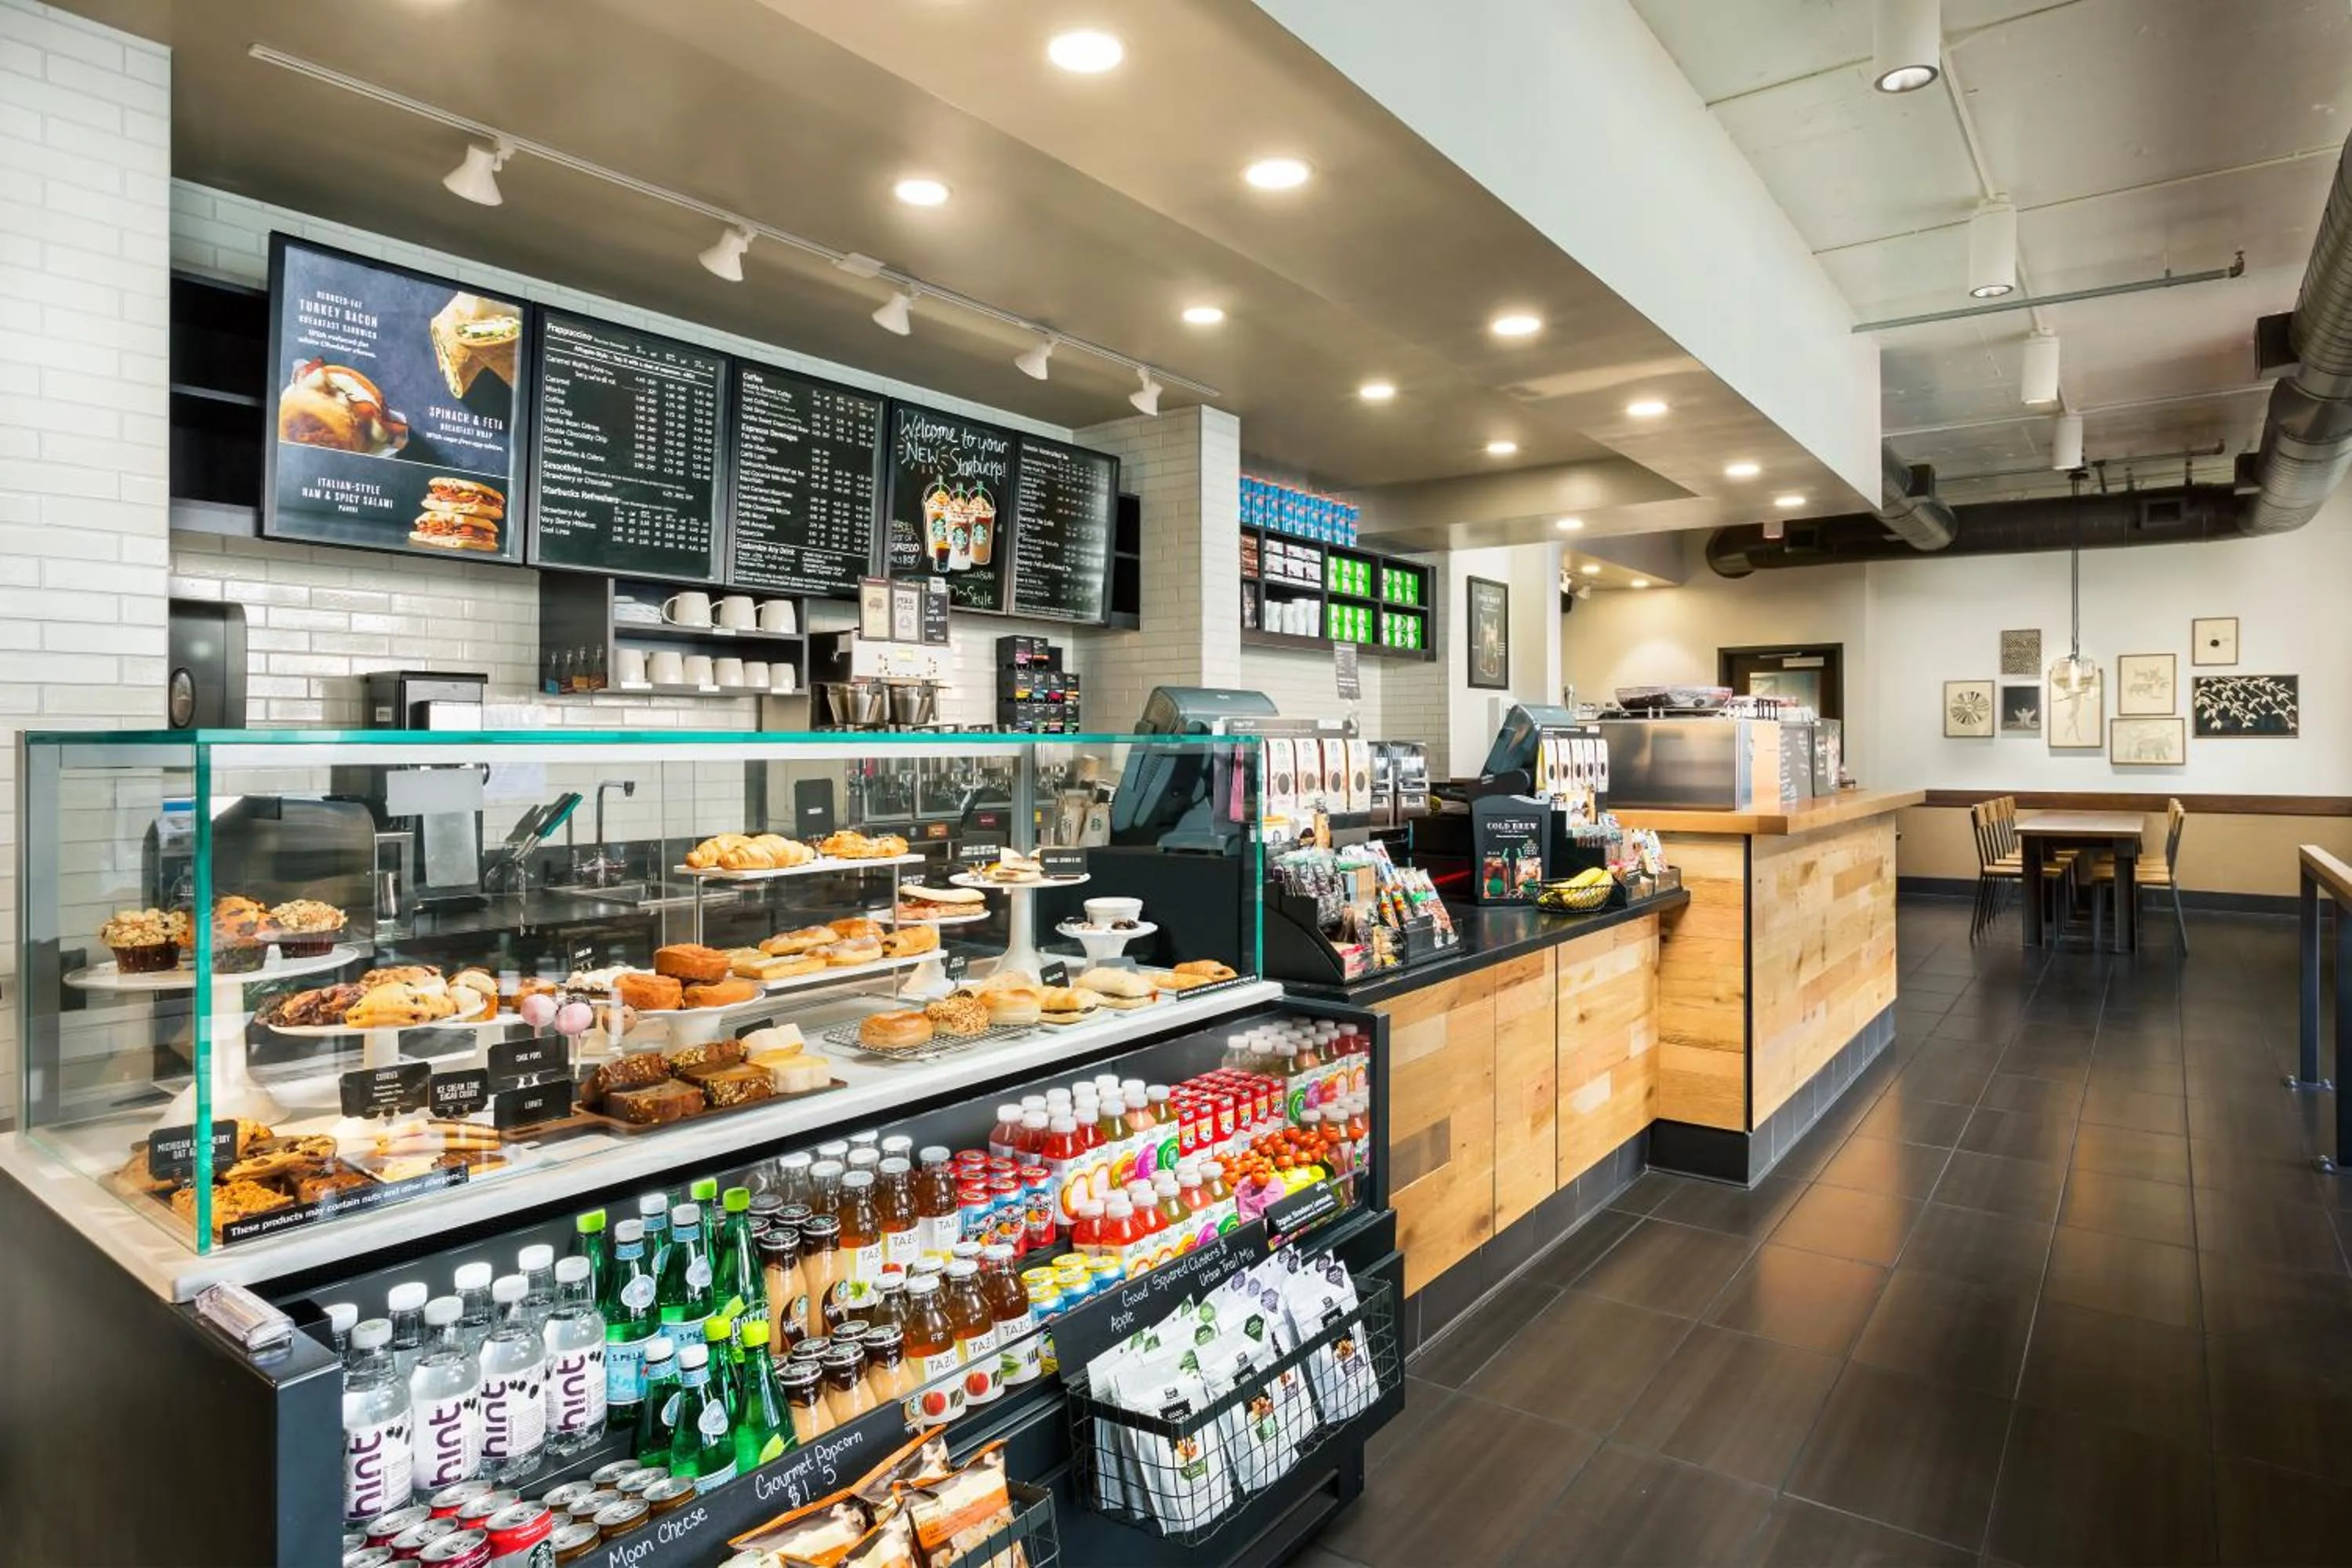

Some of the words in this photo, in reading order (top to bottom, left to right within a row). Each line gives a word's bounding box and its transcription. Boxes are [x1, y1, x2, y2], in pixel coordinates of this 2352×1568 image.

[299, 299, 340, 318] TURKEY
[345, 310, 377, 328] BACON
[299, 315, 339, 330] BREAKFAST
[546, 322, 593, 341] Frappuccino
[546, 375, 570, 386] Caramel
[742, 372, 764, 383] Coffee
[545, 395, 564, 405] Coffee
[429, 406, 470, 424] SPINACH
[473, 417, 479, 426] &
[482, 418, 503, 430] FETA
[897, 408, 958, 443] Welcome
[961, 427, 975, 448] to
[976, 436, 1009, 461] your
[543, 460, 582, 474] Smoothies
[901, 441, 939, 465] NEW
[949, 448, 1007, 485] Starbucks!
[301, 487, 321, 500] HAM
[325, 491, 332, 501] &
[333, 492, 360, 506] SPICY
[363, 495, 394, 509] SALAMI
[318, 477, 381, 495] ITALIAN-STYLE
[543, 485, 580, 498] Starbucks
[172, 1149, 187, 1160] OAT
[230, 1223, 260, 1237] These
[262, 1212, 304, 1232] products
[305, 1206, 325, 1219] may
[326, 1197, 361, 1213] contain
[361, 1192, 382, 1205] nuts
[383, 1185, 400, 1198] and
[401, 1181, 423, 1194] other
[1111, 1311, 1134, 1333] Apple
[1199, 1269, 1222, 1287] Urban
[1219, 1254, 1238, 1272] Trail
[1240, 1247, 1255, 1263] Mix
[1122, 1281, 1149, 1307] Good
[556, 1354, 586, 1432] hint
[481, 1379, 507, 1457] hint
[429, 1401, 462, 1486] hint
[349, 1431, 382, 1519] hint
[755, 1454, 813, 1500] Gourmet
[815, 1431, 863, 1470] Popcorn
[608, 1539, 654, 1568] Moon
[658, 1506, 708, 1544] Cheese
